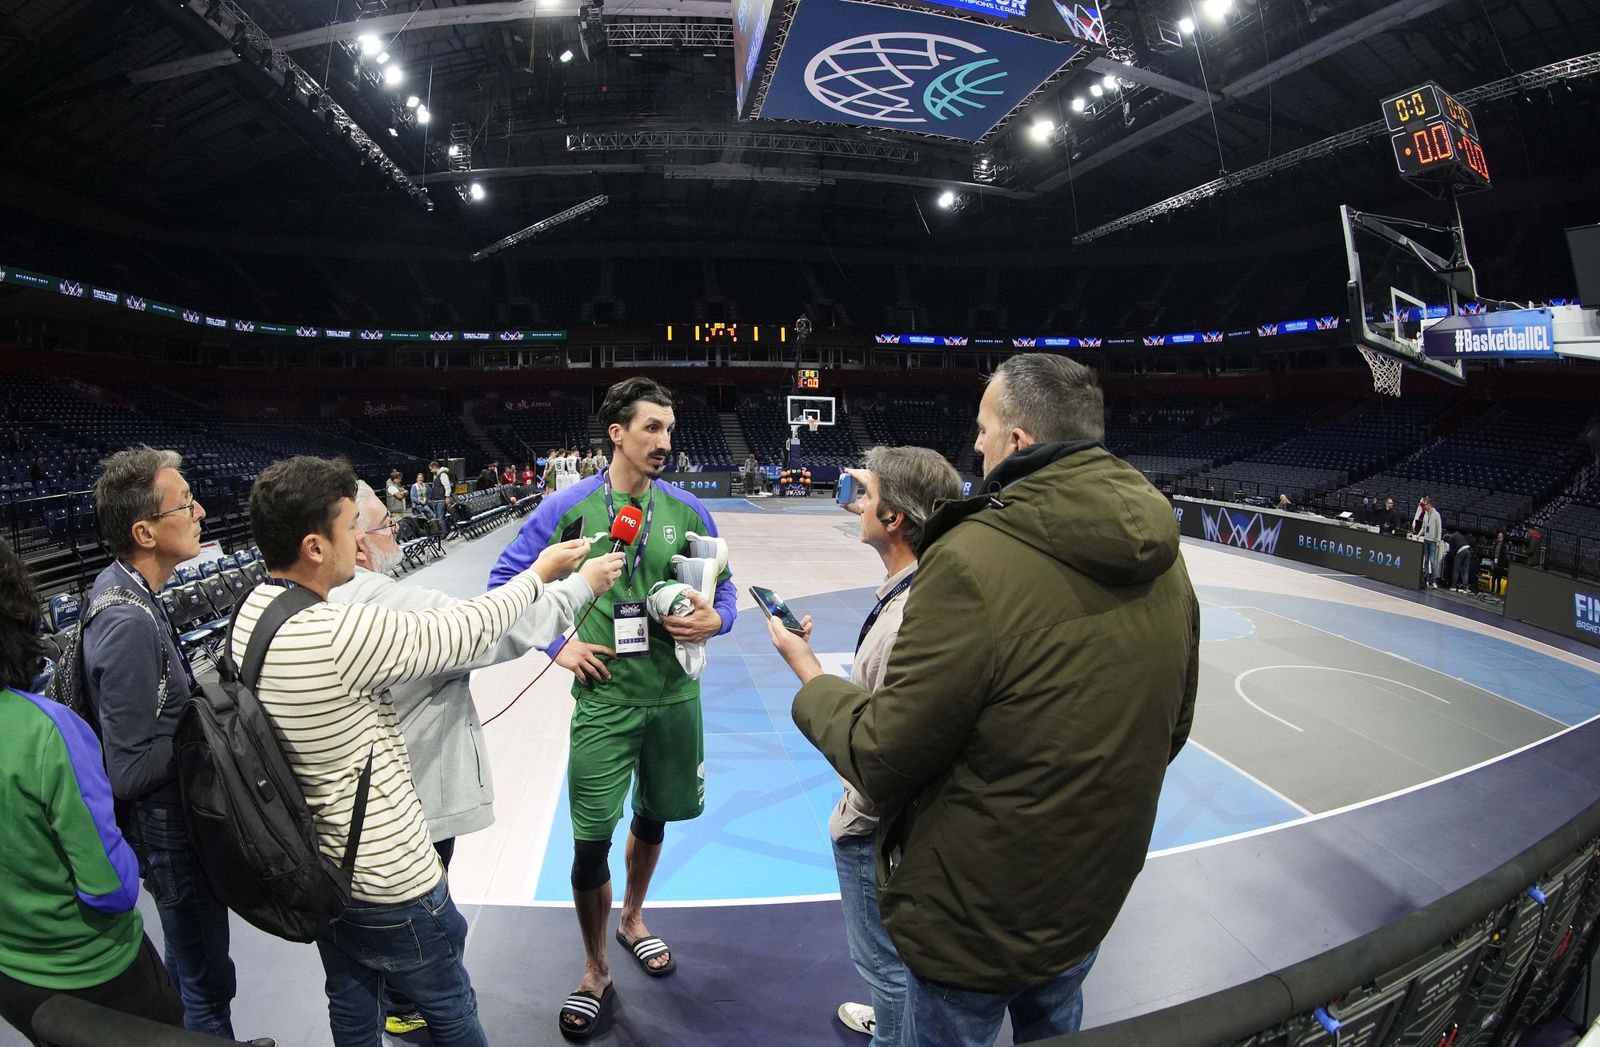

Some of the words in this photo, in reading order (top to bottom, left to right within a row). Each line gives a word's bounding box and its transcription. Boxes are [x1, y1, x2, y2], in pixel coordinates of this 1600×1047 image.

[994, 5, 1026, 17] LEAGUE
[1395, 92, 1426, 122] 0:0
[1455, 326, 1550, 353] #BasketballCL
[690, 481, 717, 489] 2024
[1298, 534, 1363, 560] BELGRADE
[1368, 550, 1402, 569] 2024
